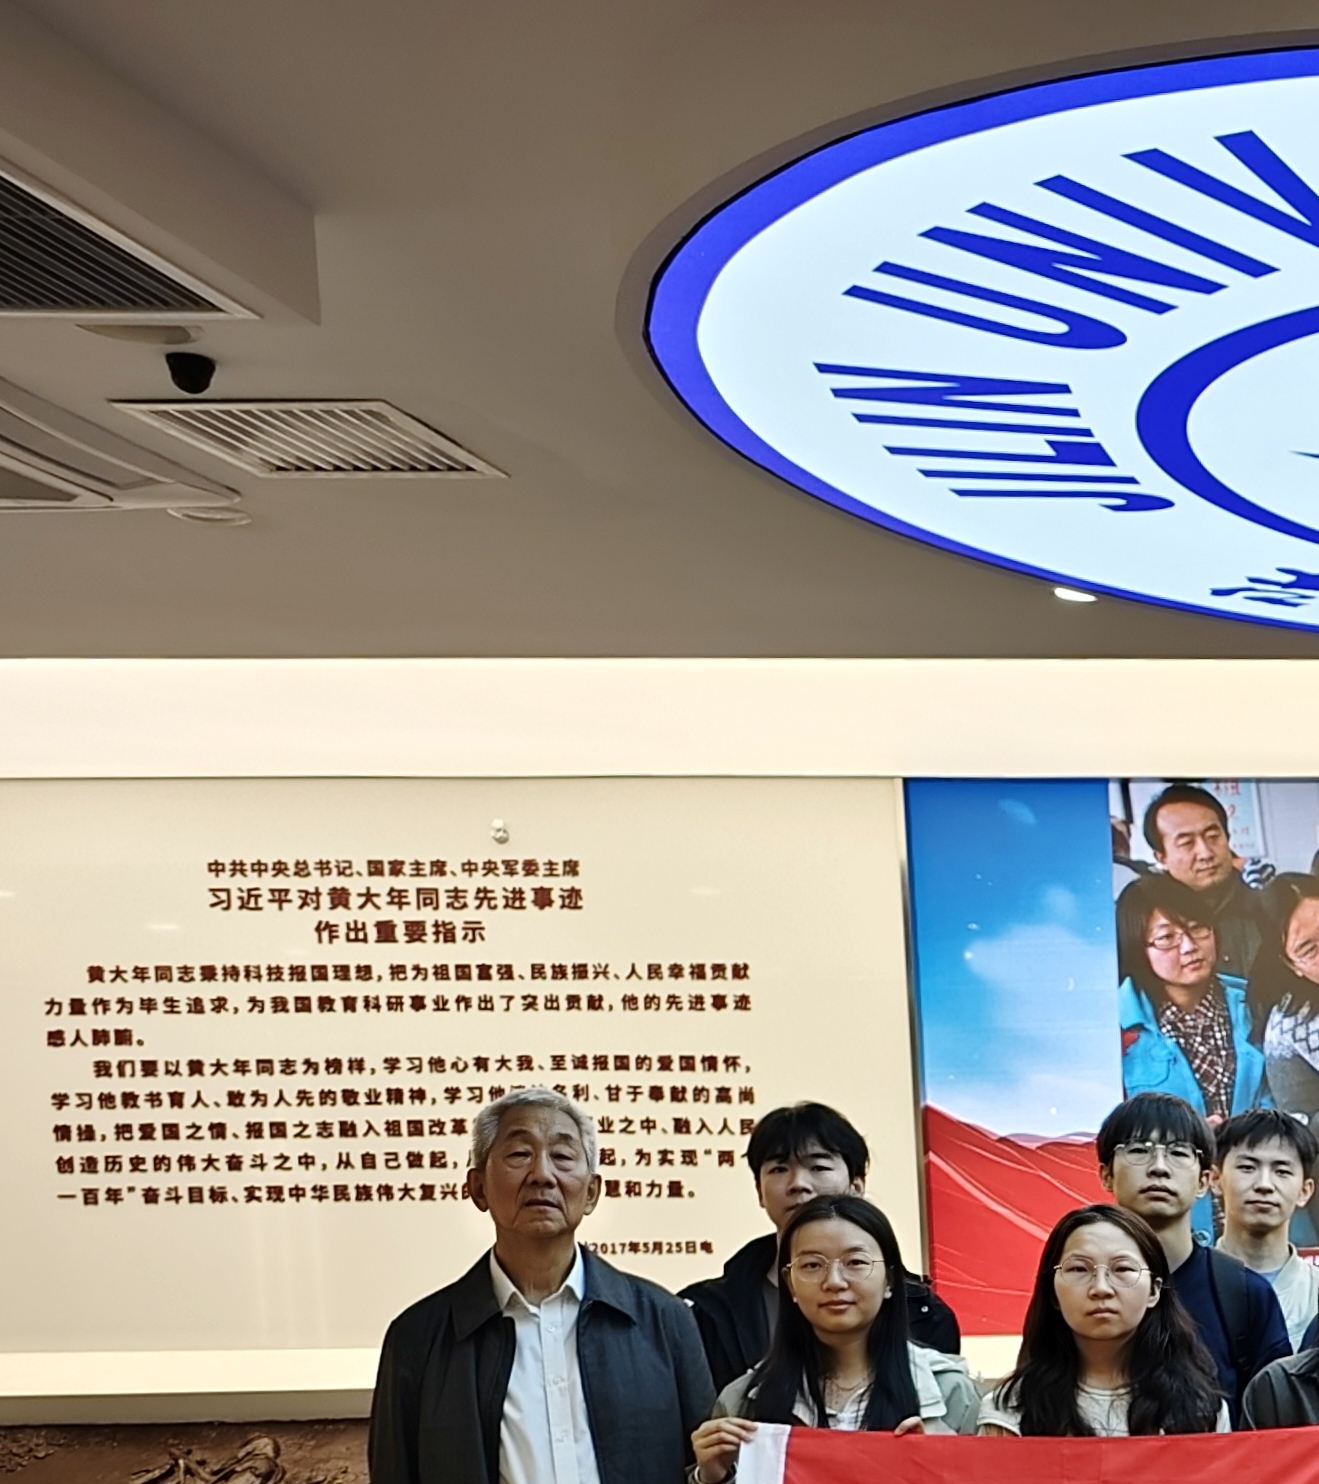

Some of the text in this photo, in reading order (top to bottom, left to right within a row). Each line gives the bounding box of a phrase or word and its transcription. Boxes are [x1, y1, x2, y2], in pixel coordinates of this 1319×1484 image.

[813, 362, 1175, 511] JILIN
[206, 858, 580, 879] 中共中央总书记、国家主席、中央军委主席
[207, 885, 584, 912] 习近平对黄大年同志先进事迹
[313, 918, 486, 945] 作出重要指示
[46, 1027, 146, 1049] 感人肺腑。
[50, 1083, 755, 1112] 学习他教书育人、敢为人先的敬业精神,学习他名利、甘于奉献的高尚
[585, 1240, 714, 1255] 2017年5月25日电
